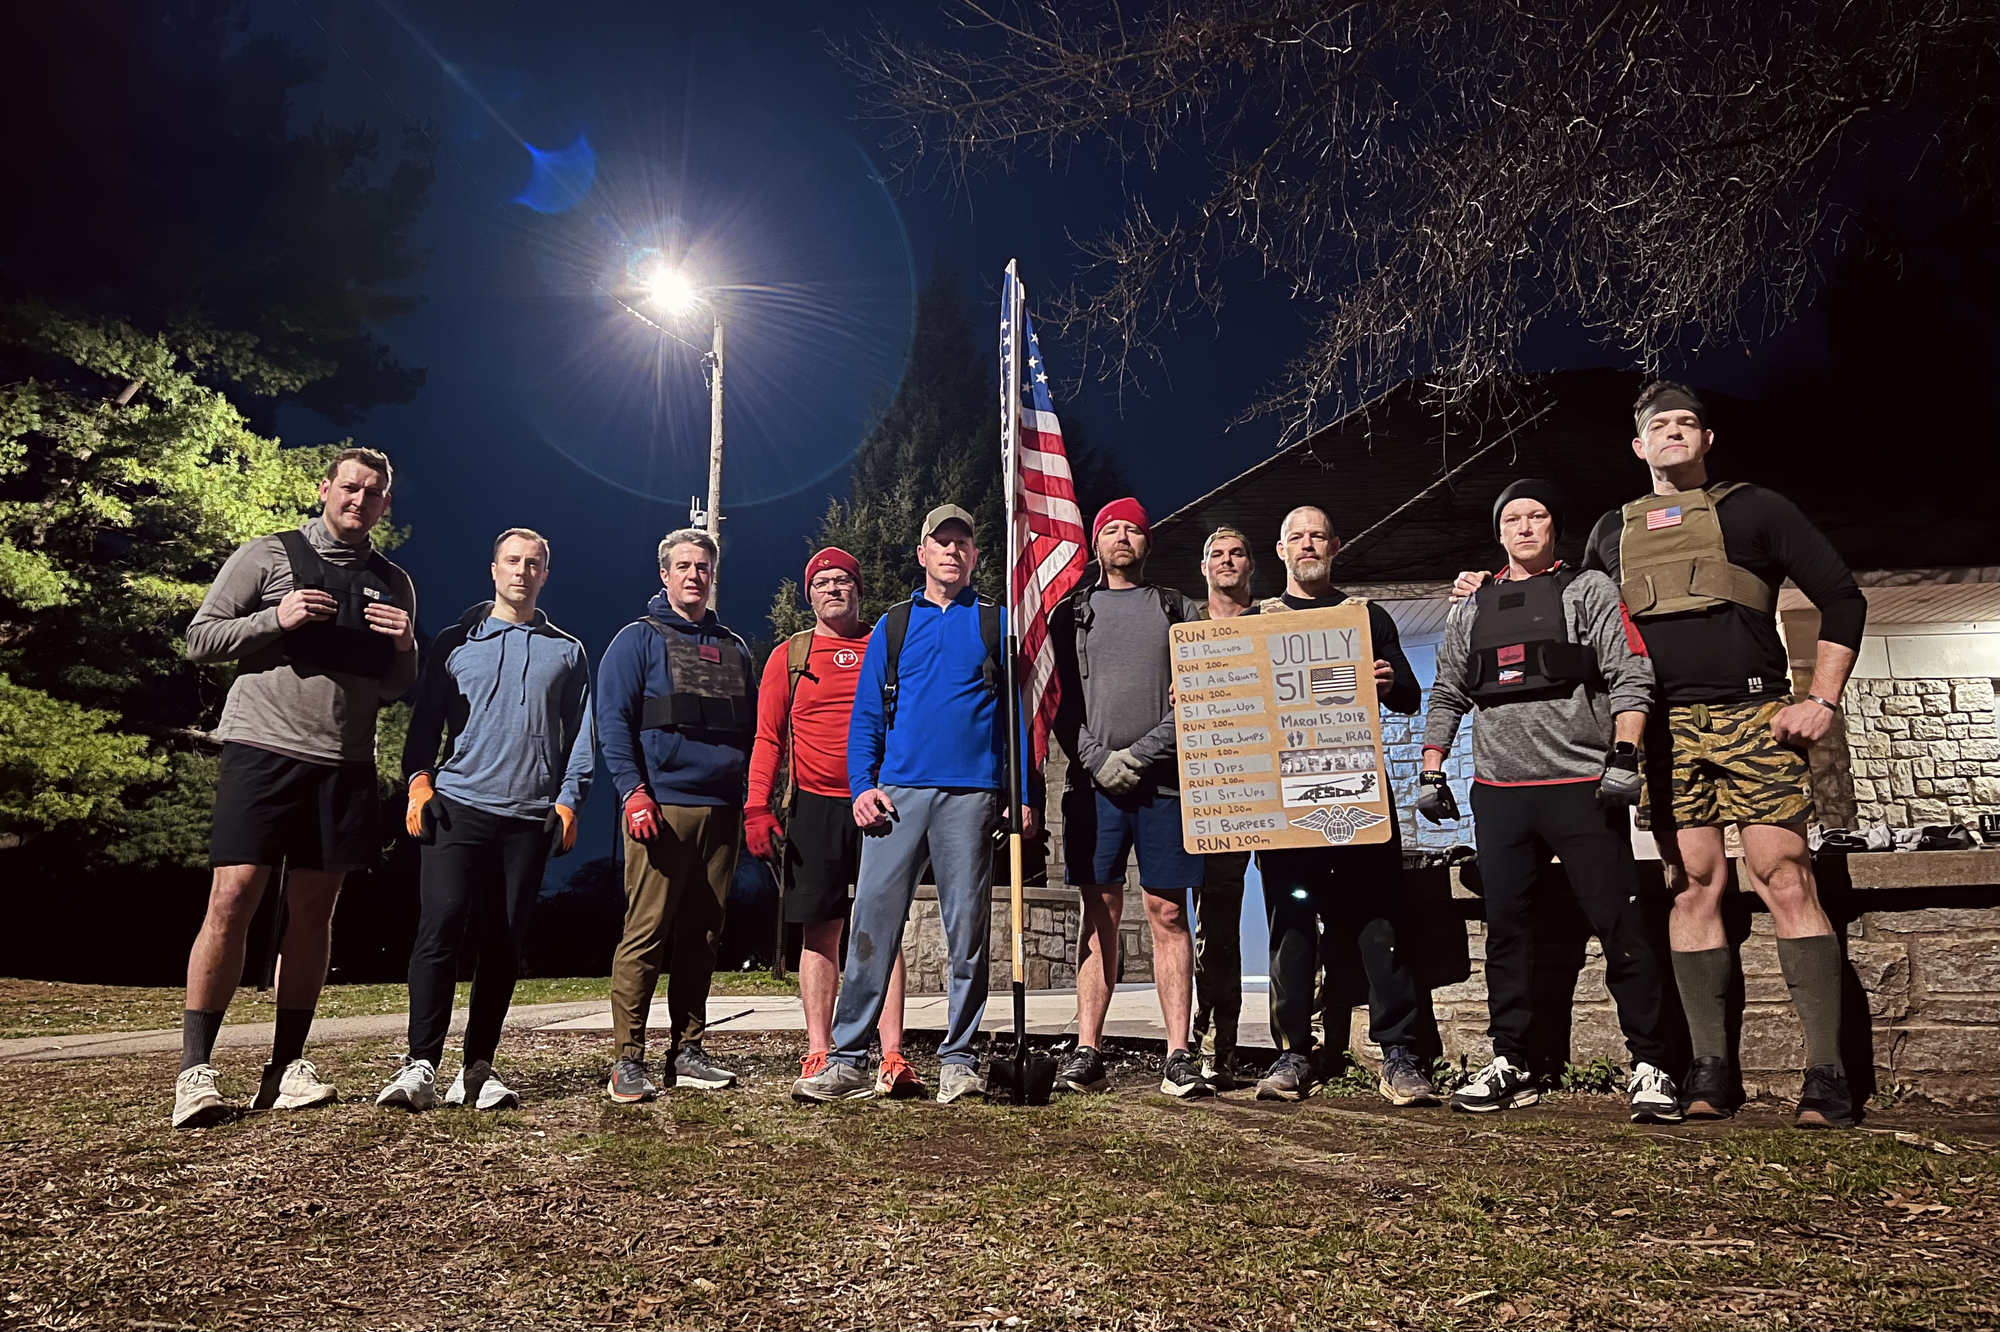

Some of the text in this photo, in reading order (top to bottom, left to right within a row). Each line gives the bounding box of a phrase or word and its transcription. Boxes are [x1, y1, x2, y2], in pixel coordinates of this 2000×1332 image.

[1174, 627, 1239, 643] RUN 200m
[1180, 647, 1196, 658] 51
[1272, 629, 1352, 666] JOLLY
[1177, 661, 1228, 673] RUN 200m
[1183, 677, 1198, 688] 51
[1208, 675, 1225, 685] AIR
[1276, 671, 1304, 701] 51
[1180, 690, 1231, 703] RUN 200m
[1183, 706, 1198, 718] 51
[1183, 720, 1234, 732] RUN 200m
[1281, 715, 1317, 728] MARCH
[1336, 712, 1365, 723] 2018
[1187, 735, 1203, 748] 51
[1212, 733, 1234, 746] BOX
[1346, 730, 1372, 741] IRAQ
[1185, 752, 1208, 760] RUN
[1189, 763, 1244, 776] 51 DIPS
[1189, 779, 1214, 788] RUN
[1192, 791, 1208, 803] 51
[1193, 805, 1252, 818] RUN 200m
[1195, 819, 1275, 834] 51 BURPEES
[1197, 835, 1270, 852] RUN 200m
